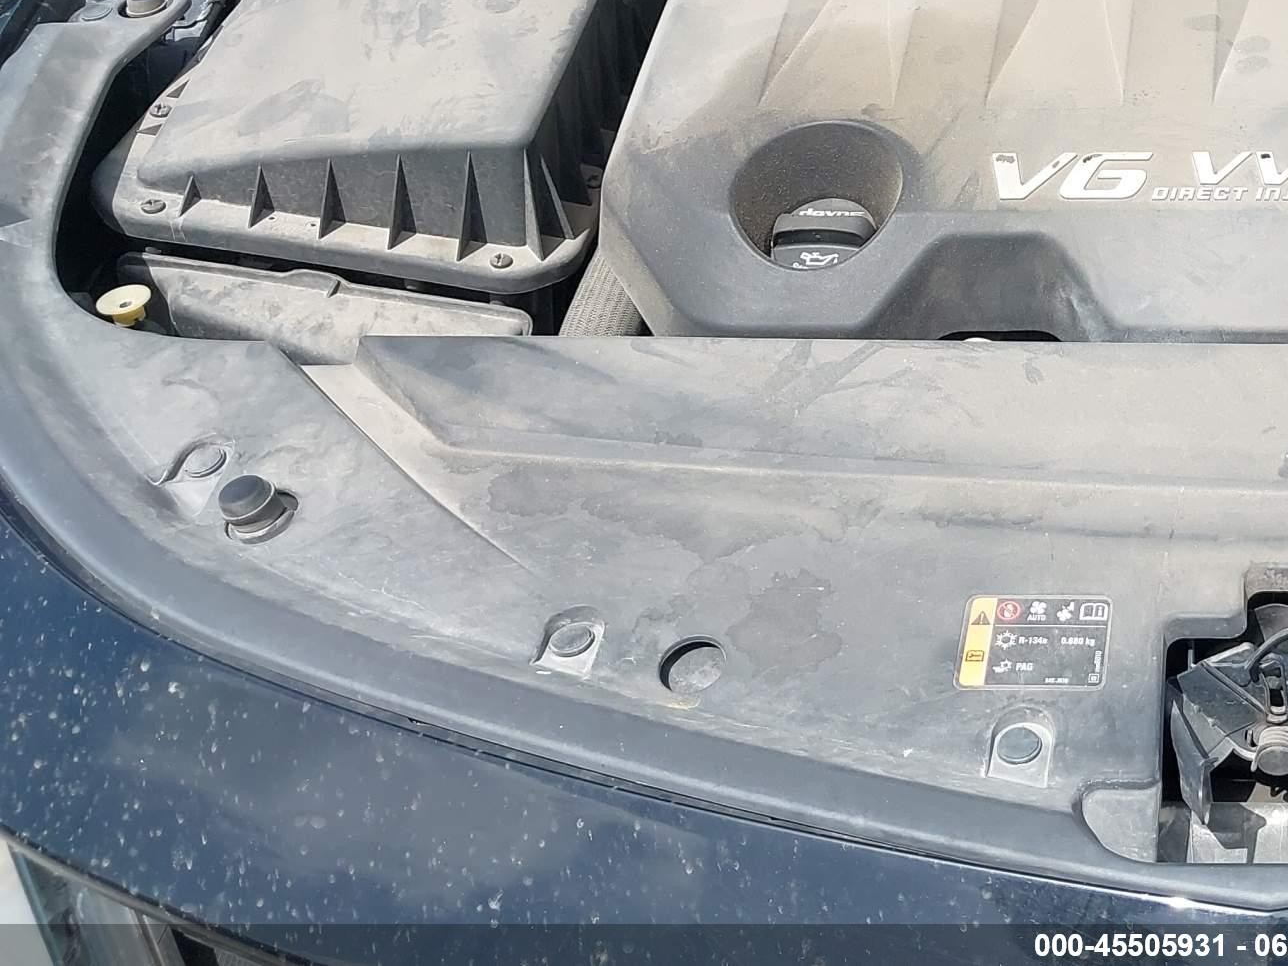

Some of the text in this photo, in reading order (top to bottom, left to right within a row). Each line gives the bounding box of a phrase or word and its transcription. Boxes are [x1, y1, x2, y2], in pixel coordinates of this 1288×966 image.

[992, 151, 1154, 201] V6
[1150, 186, 1249, 202] DIRECT
[1026, 614, 1047, 622] AUTO
[1018, 636, 1049, 645] R-134a
[1085, 636, 1096, 647] kg
[1015, 662, 1035, 672] PAG
